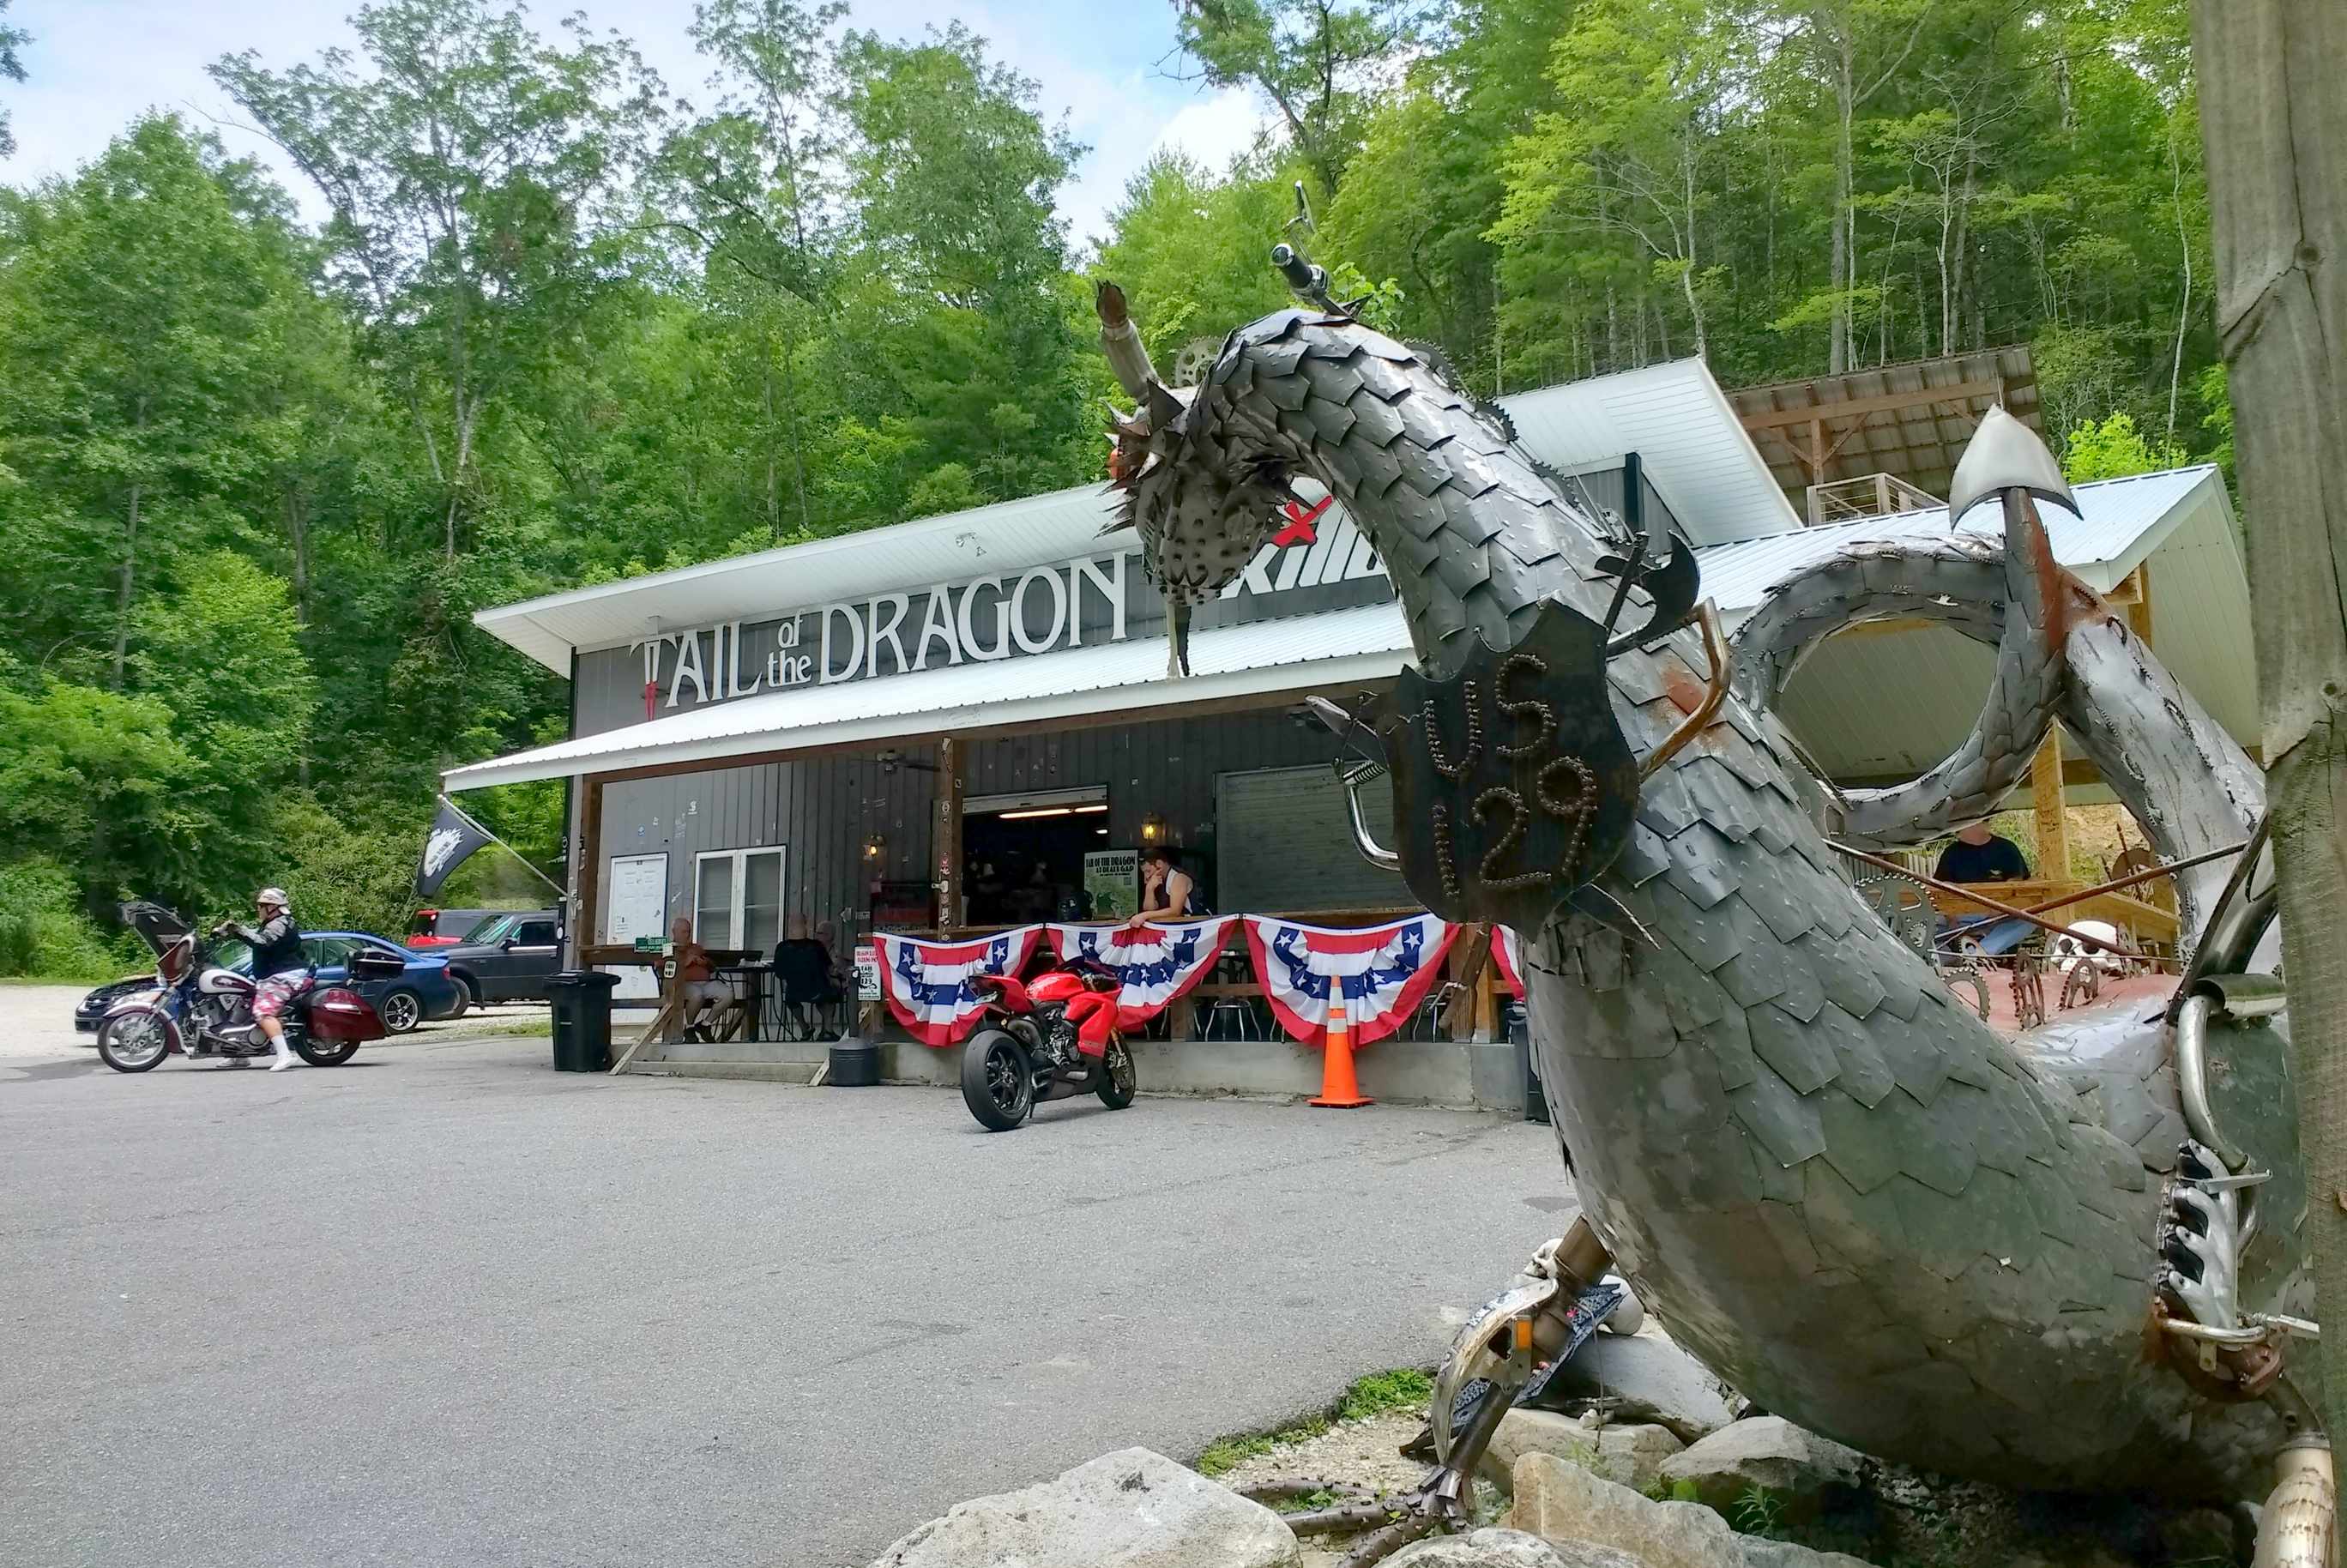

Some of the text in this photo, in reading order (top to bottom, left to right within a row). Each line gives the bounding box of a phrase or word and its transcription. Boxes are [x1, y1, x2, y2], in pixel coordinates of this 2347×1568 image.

[629, 552, 1128, 719] TAIL of the DRAGON
[1423, 653, 1558, 782] US
[1111, 856, 1136, 865] DRAGON
[1432, 755, 1598, 898] 129
